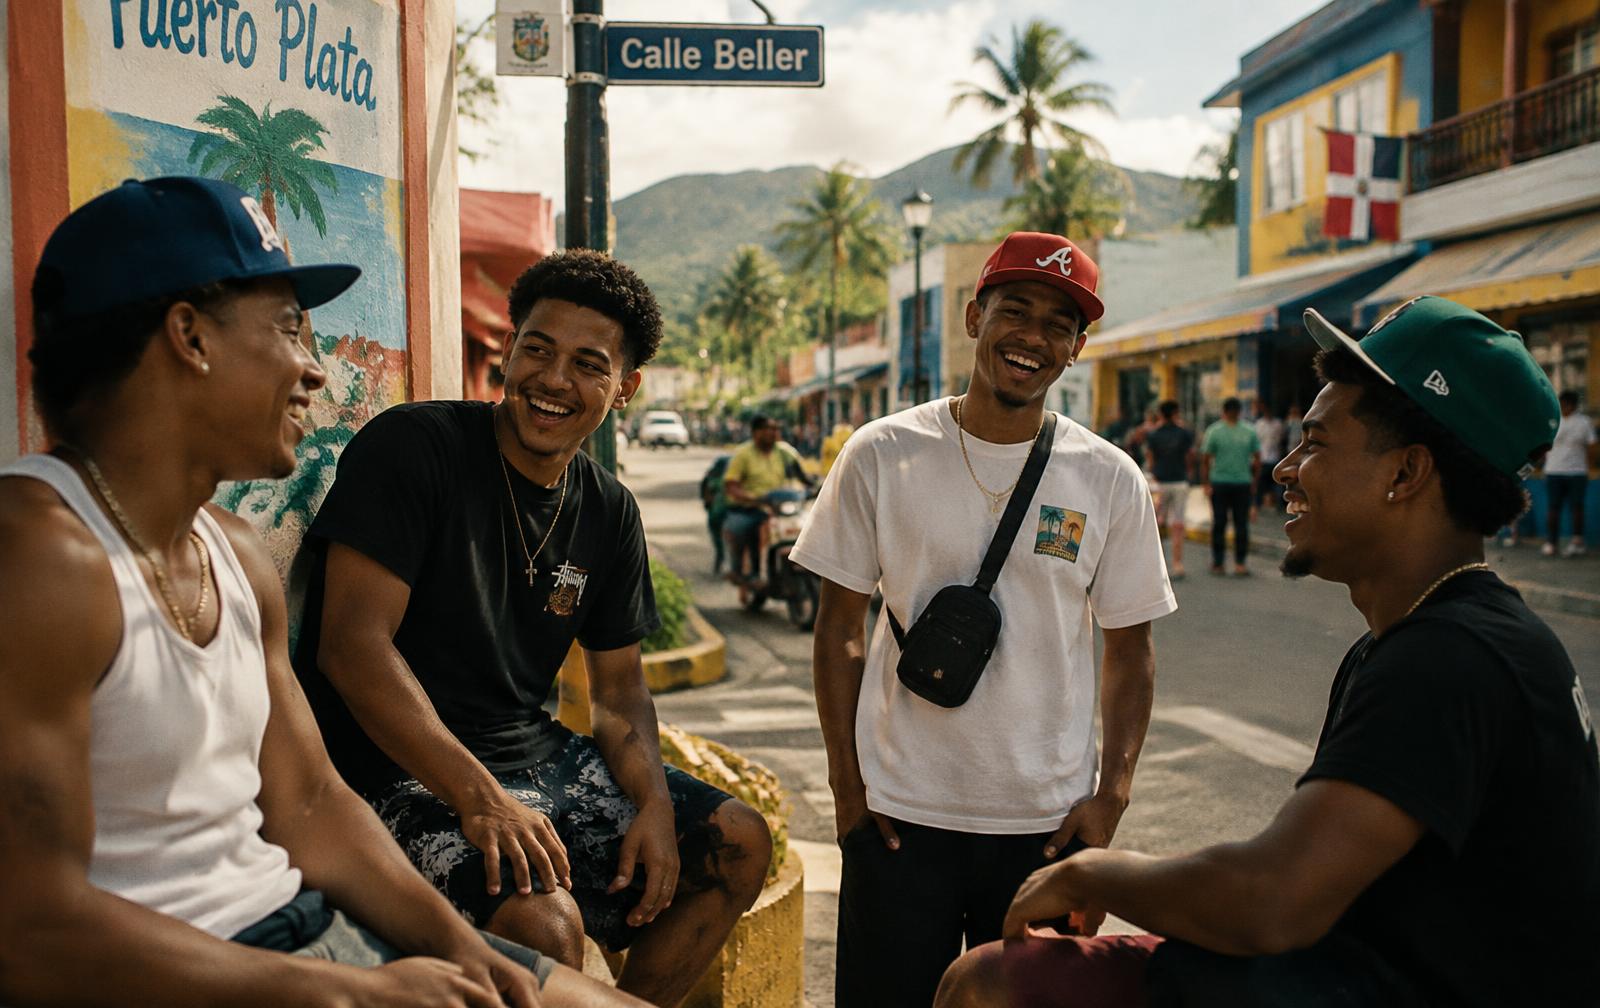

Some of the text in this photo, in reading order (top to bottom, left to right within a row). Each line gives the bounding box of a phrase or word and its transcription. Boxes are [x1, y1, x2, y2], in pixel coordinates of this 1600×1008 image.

[275, 0, 376, 111] Plata
[620, 37, 808, 71] Calle Beller
[1035, 246, 1072, 276] A
